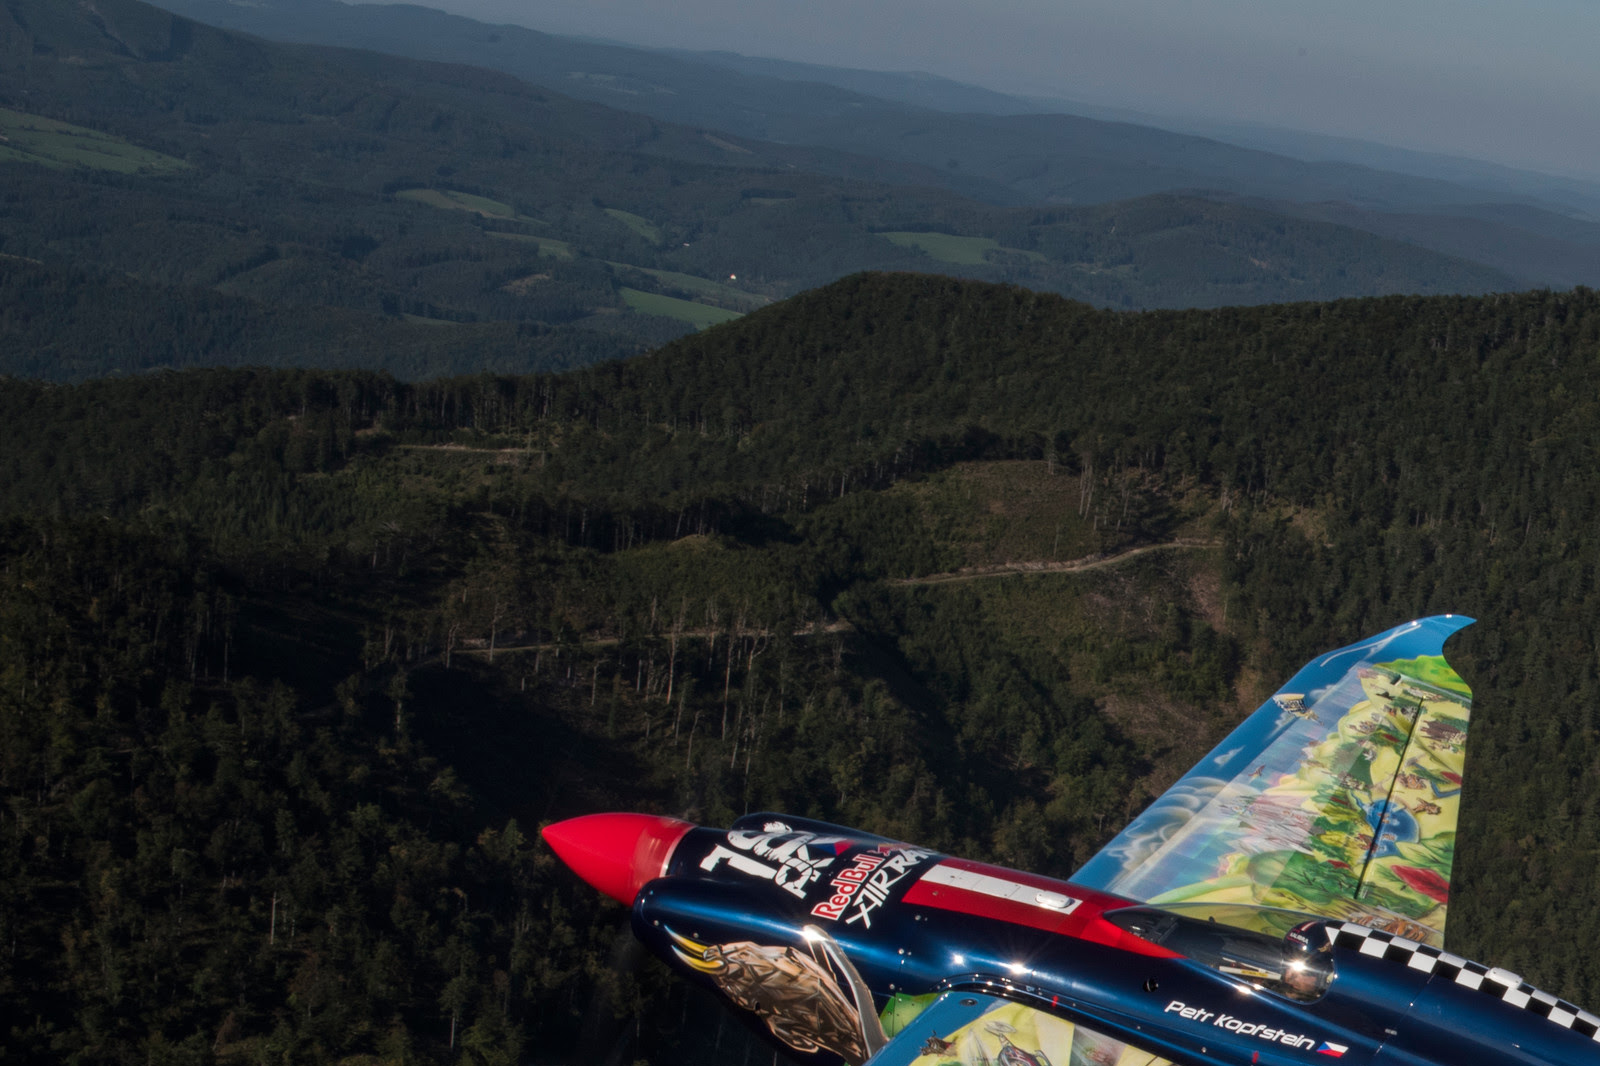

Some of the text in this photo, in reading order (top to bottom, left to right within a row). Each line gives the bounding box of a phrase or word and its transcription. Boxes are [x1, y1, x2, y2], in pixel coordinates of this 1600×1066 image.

[845, 844, 937, 929] AIR RA
[1164, 1000, 1315, 1050] Petr Kopfstein
